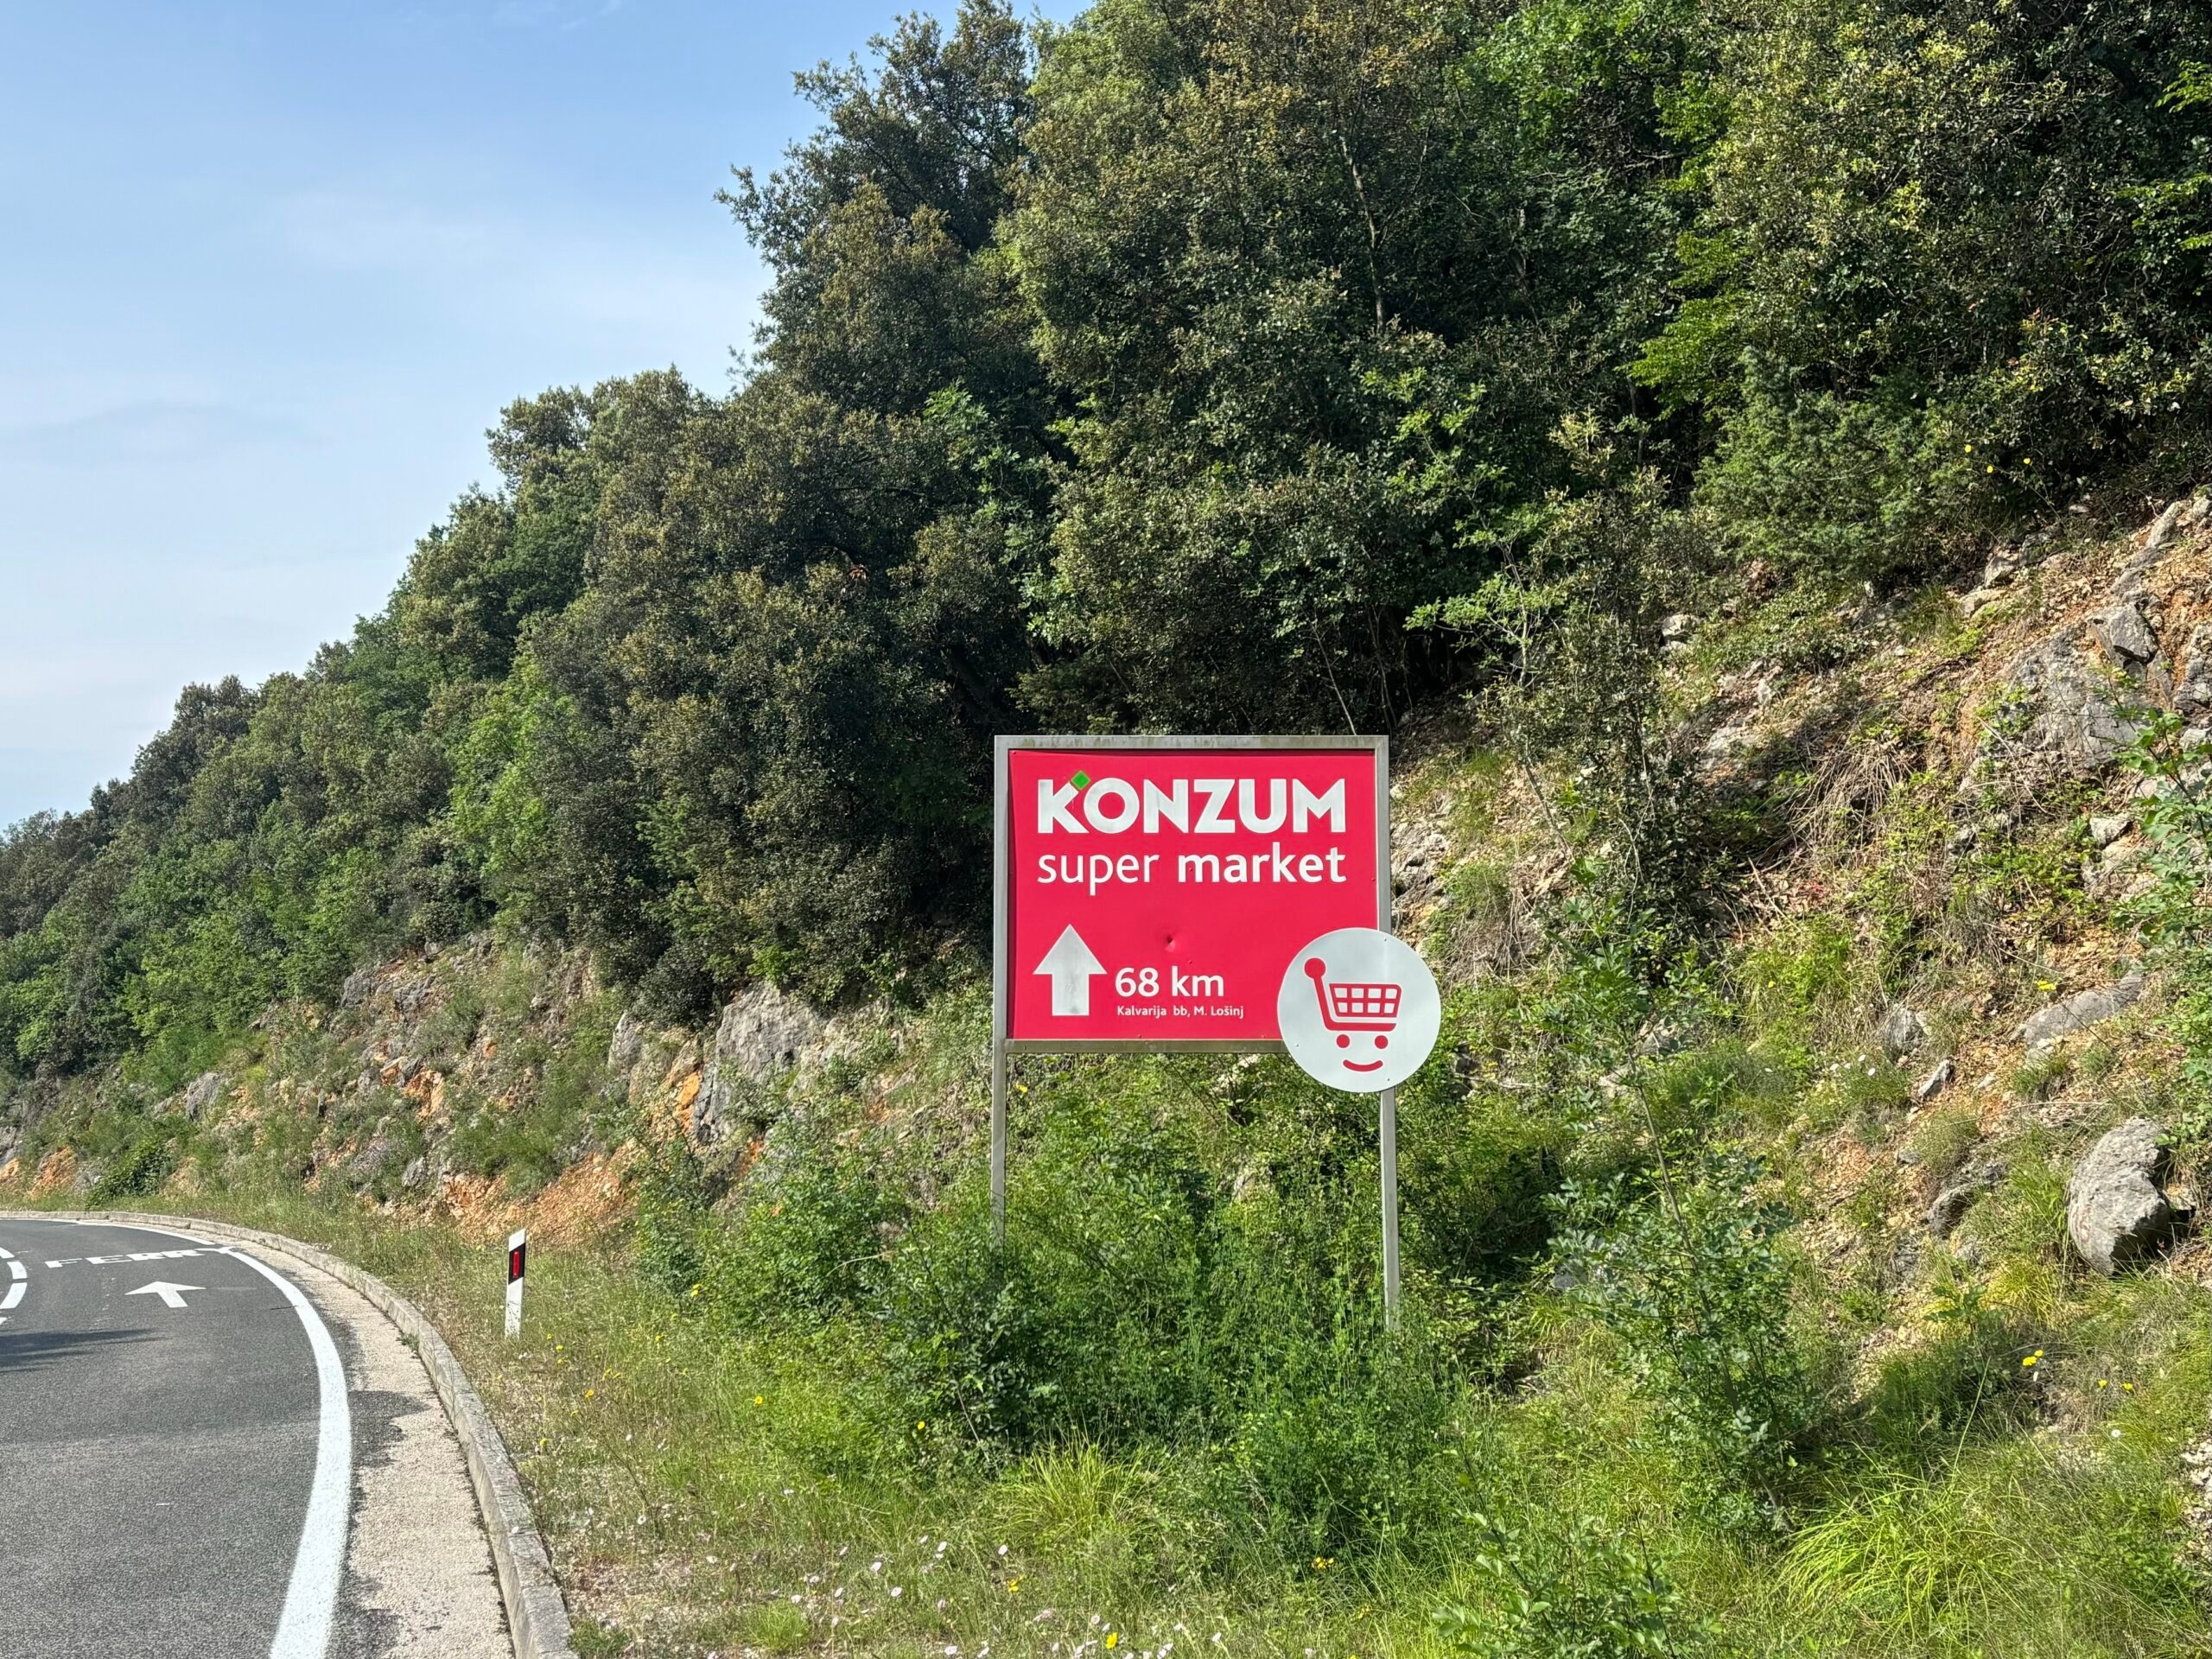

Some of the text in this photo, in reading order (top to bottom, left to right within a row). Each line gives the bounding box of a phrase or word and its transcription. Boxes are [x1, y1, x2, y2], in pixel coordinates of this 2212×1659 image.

[1037, 776, 1346, 834] KONZUM
[1037, 842, 1347, 896] super market
[1115, 965, 1224, 998] 68 km
[1116, 1005, 1244, 1020] Kalvarija bb, M. Lošinj
[45, 1246, 236, 1268] FERRY
